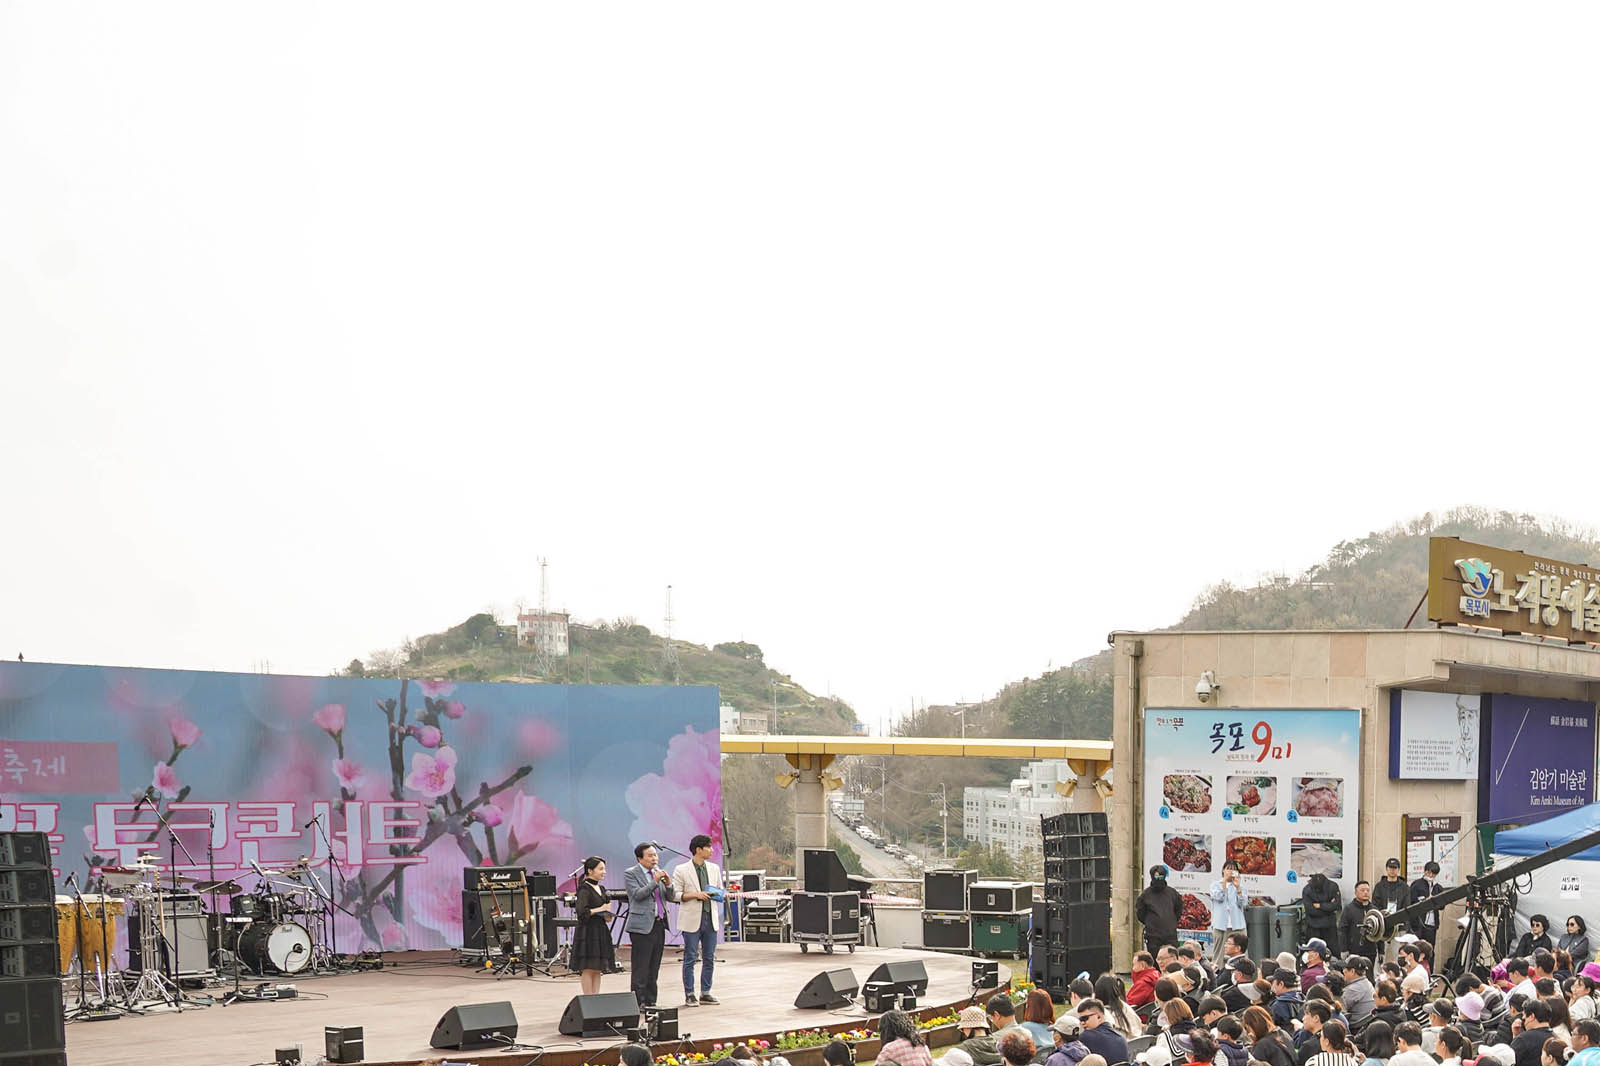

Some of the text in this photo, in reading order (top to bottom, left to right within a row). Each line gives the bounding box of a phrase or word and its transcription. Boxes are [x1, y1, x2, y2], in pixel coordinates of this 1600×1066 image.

[1466, 598, 1489, 617] 목포시
[1209, 722, 1245, 754] 목포
[0, 748, 66, 785] 축제
[1529, 768, 1588, 791] 김암기 미술관
[1530, 795, 1541, 806] Kim
[1553, 795, 1572, 806] Museum
[1572, 794, 1578, 806] of
[93, 801, 429, 874] 토크콘서트
[491, 872, 511, 880] Marshall
